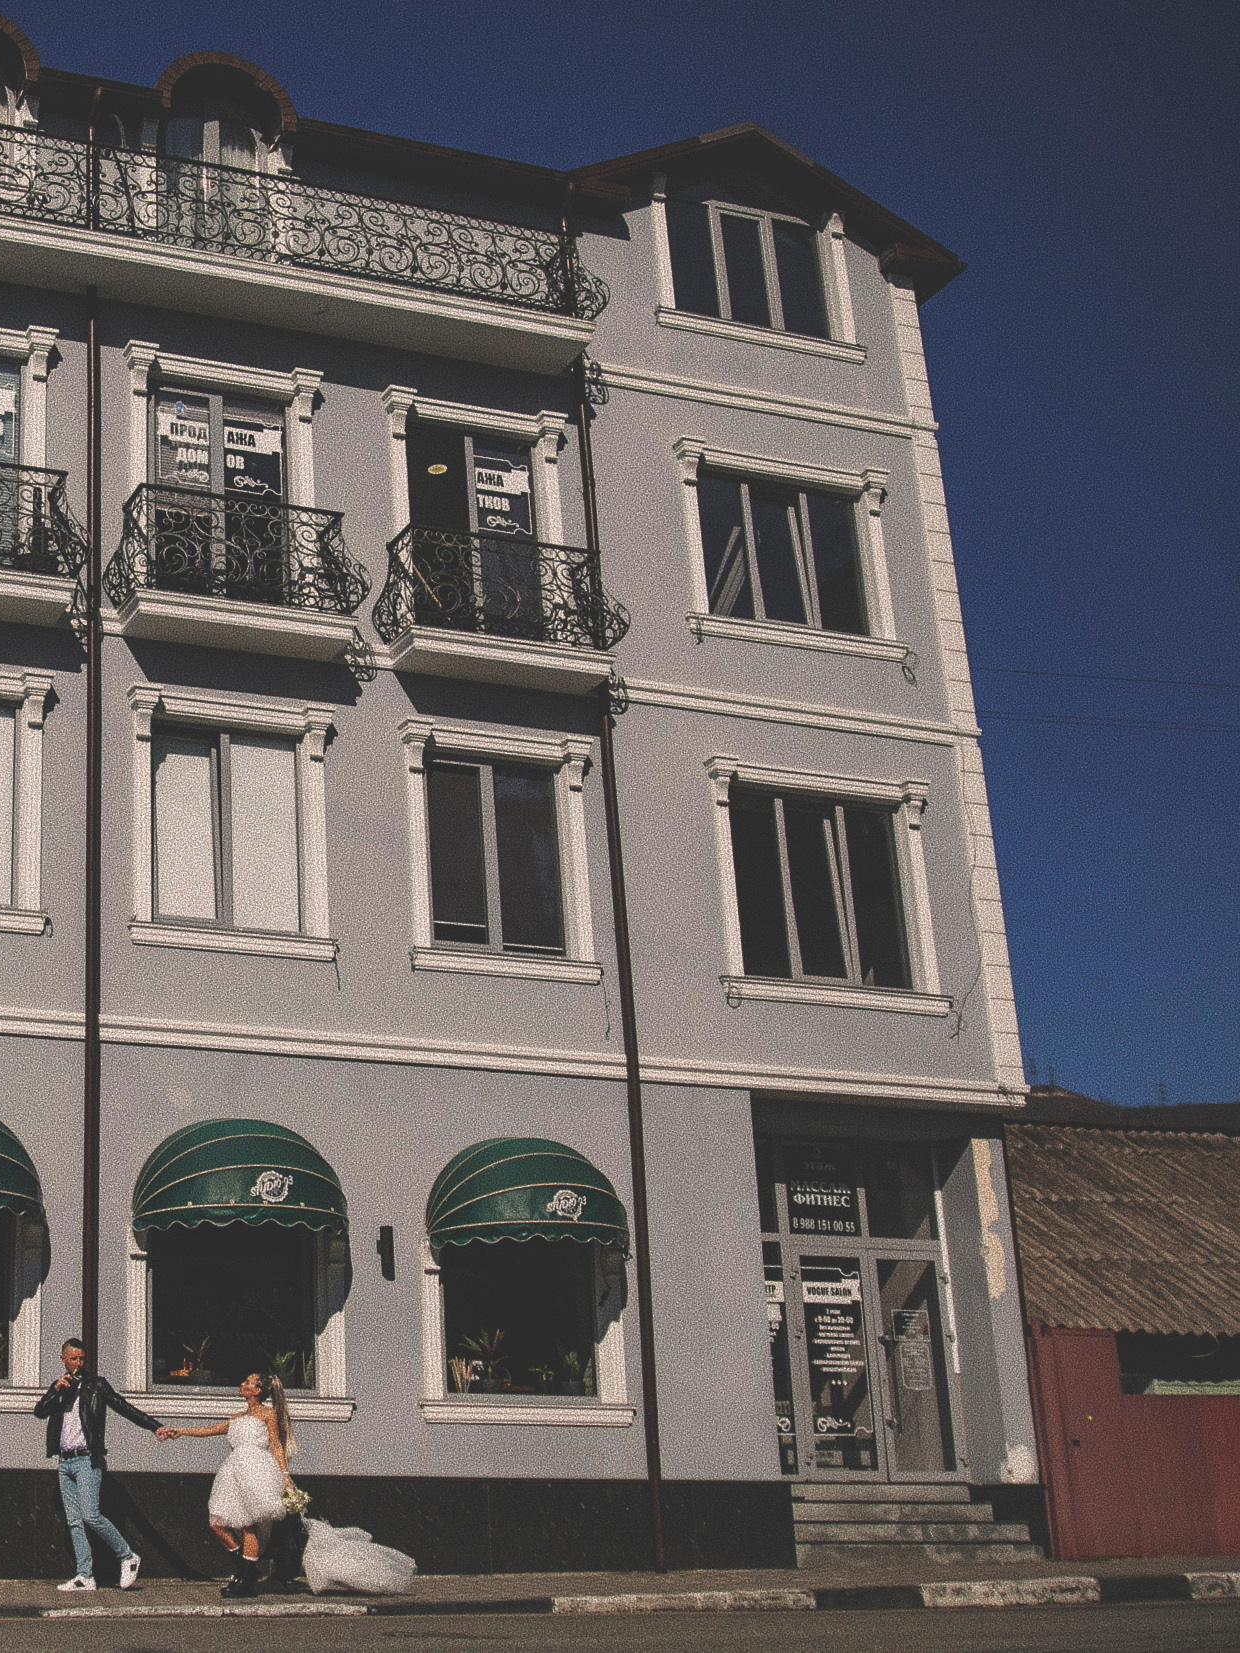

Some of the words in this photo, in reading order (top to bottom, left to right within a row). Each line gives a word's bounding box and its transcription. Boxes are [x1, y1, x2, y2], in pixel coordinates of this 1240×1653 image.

[170, 422, 208, 442] ПРОД
[227, 431, 256, 448] АЖА
[226, 453, 245, 470] ОВ
[476, 471, 505, 487] АЖА
[793, 1193, 851, 1207] ФИТНЕС
[793, 1217, 799, 1229] 8
[800, 1218, 816, 1230] 988
[817, 1219, 831, 1231] 151
[833, 1220, 844, 1232] 00
